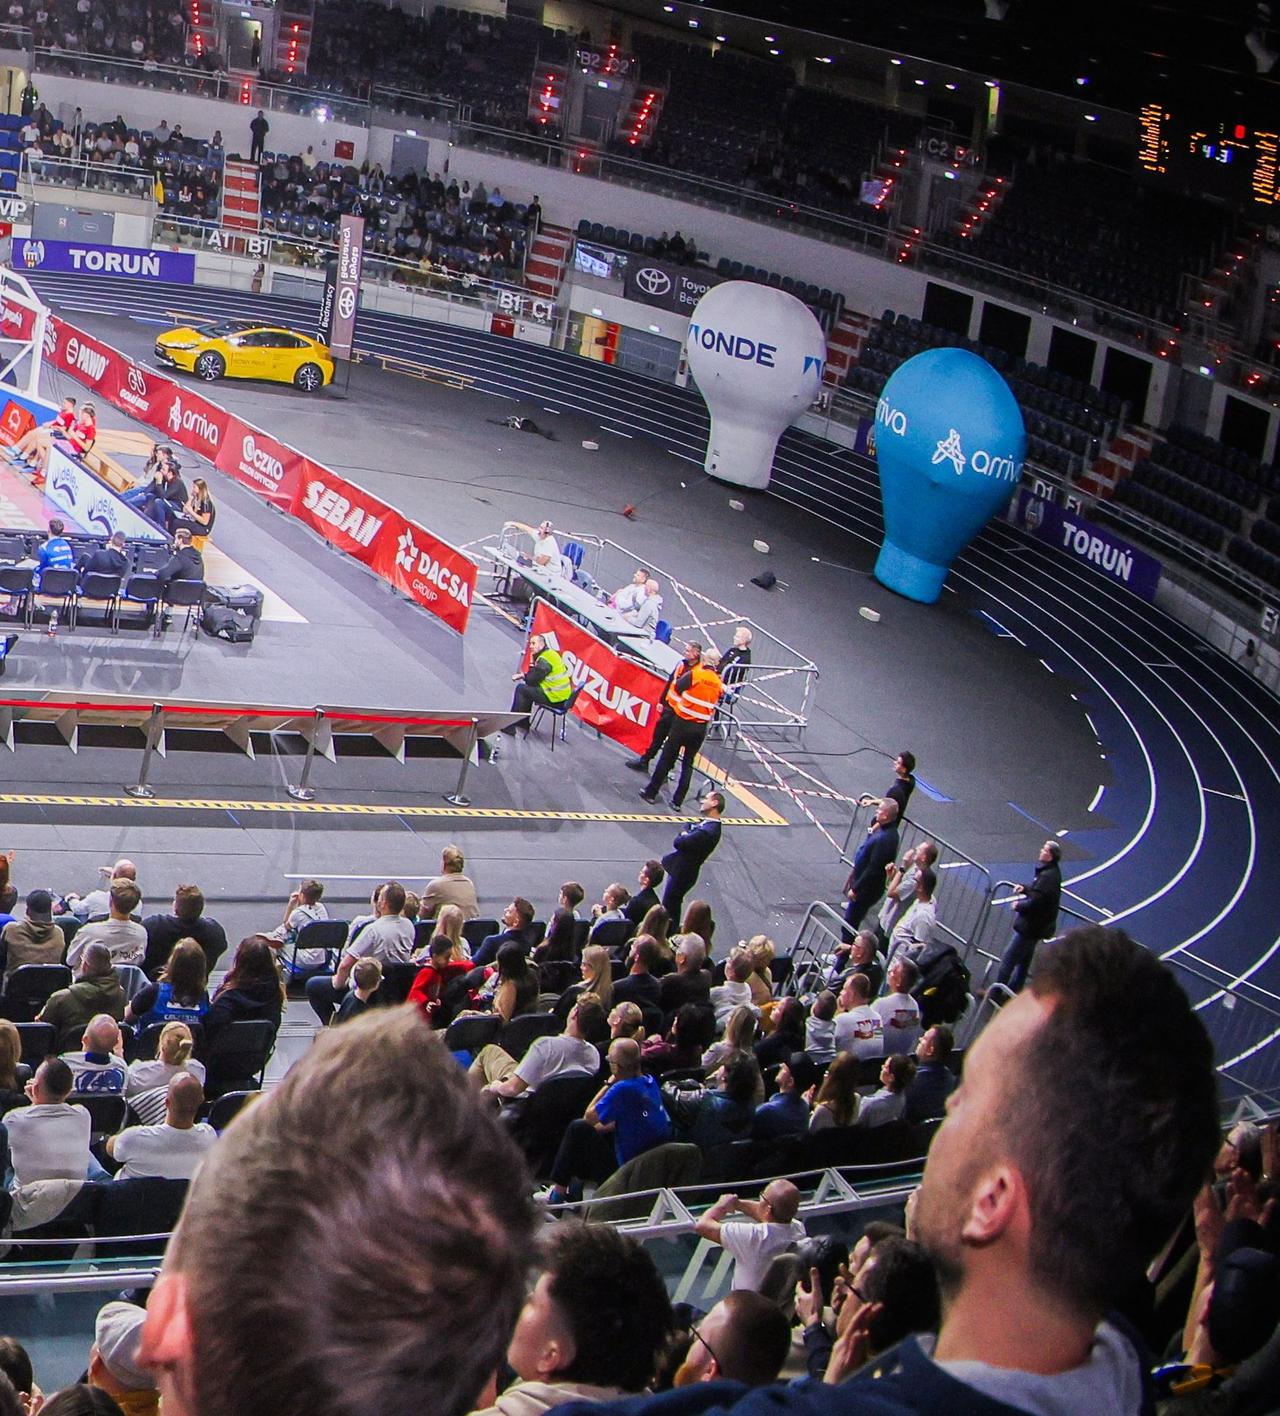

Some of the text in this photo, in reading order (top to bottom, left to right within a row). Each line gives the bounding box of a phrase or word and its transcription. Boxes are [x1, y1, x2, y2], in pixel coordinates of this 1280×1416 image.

[207, 230, 229, 248] A1
[248, 238, 269, 255] B1
[68, 252, 160, 277] TORUŃ
[322, 284, 336, 328] Bednarscy
[500, 292, 521, 311] B1
[532, 301, 552, 319] C1
[76, 347, 109, 382] PAWO
[701, 328, 778, 368] ONDE
[182, 409, 219, 446] arriva
[971, 450, 1024, 483] arriv
[301, 480, 383, 547] SEBAN
[1062, 520, 1133, 581] TORUŃ
[412, 579, 438, 602] GROUP
[417, 552, 470, 608] DACSA
[560, 650, 652, 728] SUZUKI
